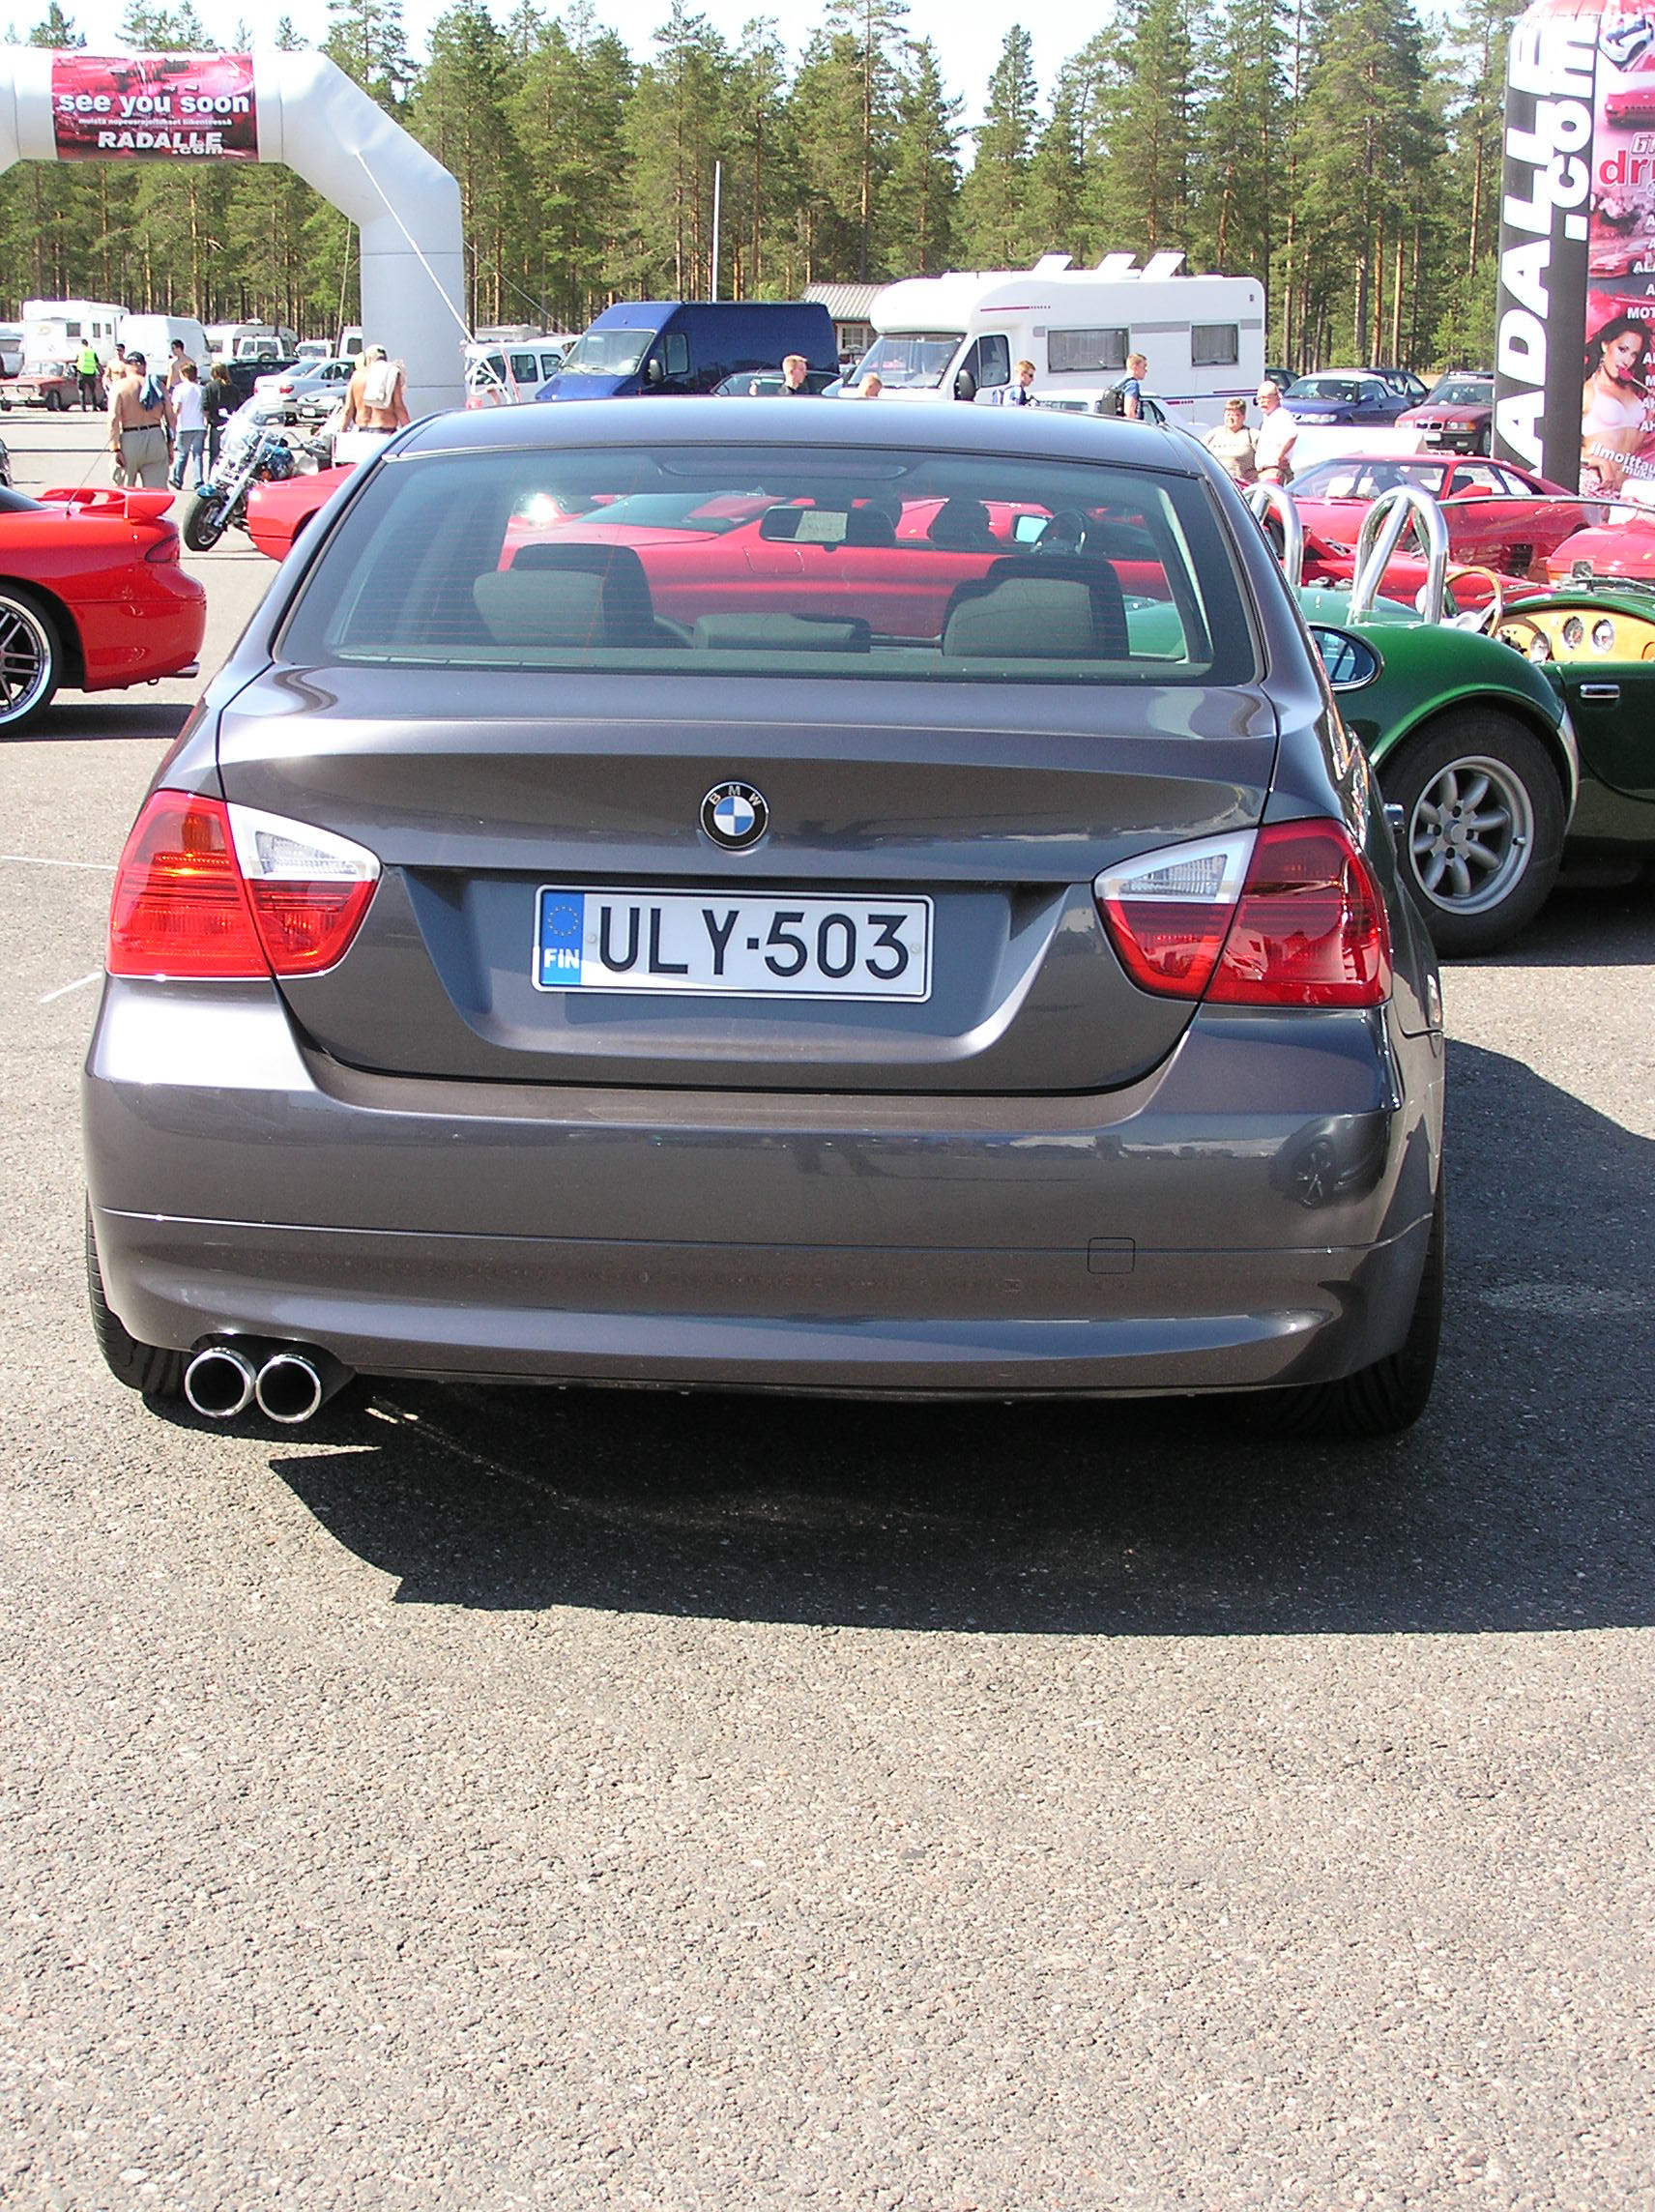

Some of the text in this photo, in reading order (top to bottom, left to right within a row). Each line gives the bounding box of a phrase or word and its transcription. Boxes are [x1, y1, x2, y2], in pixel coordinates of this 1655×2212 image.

[59, 95, 249, 117] see you soon
[98, 131, 223, 148] RADALLE
[171, 145, 224, 155] .com
[1495, 17, 1553, 479] ADALLE
[708, 785, 762, 806] BMW
[598, 905, 910, 980] ULY-503
[543, 947, 580, 970] FIN
